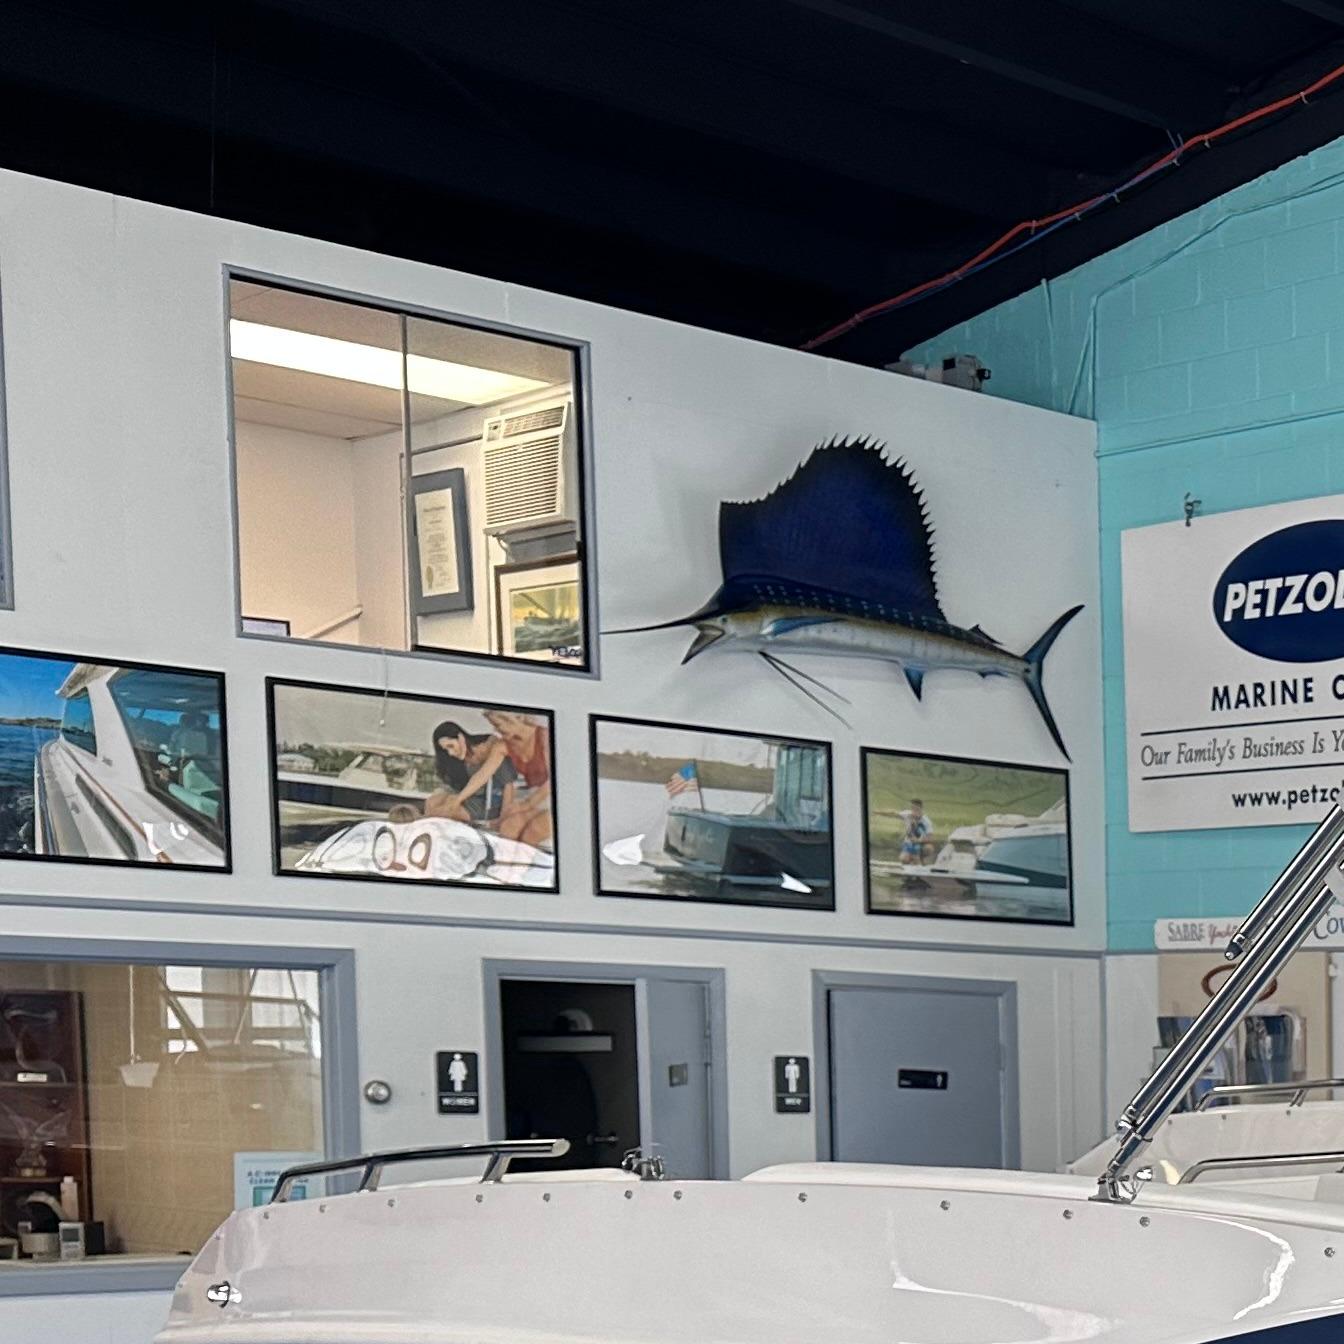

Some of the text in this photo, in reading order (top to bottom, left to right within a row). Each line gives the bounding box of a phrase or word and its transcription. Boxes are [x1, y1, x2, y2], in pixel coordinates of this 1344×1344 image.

[1210, 677, 1314, 711] MARINE
[1141, 744, 1171, 766] Our
[1176, 738, 1235, 767] Family's
[1242, 736, 1305, 759] Business
[1311, 731, 1325, 754] Is
